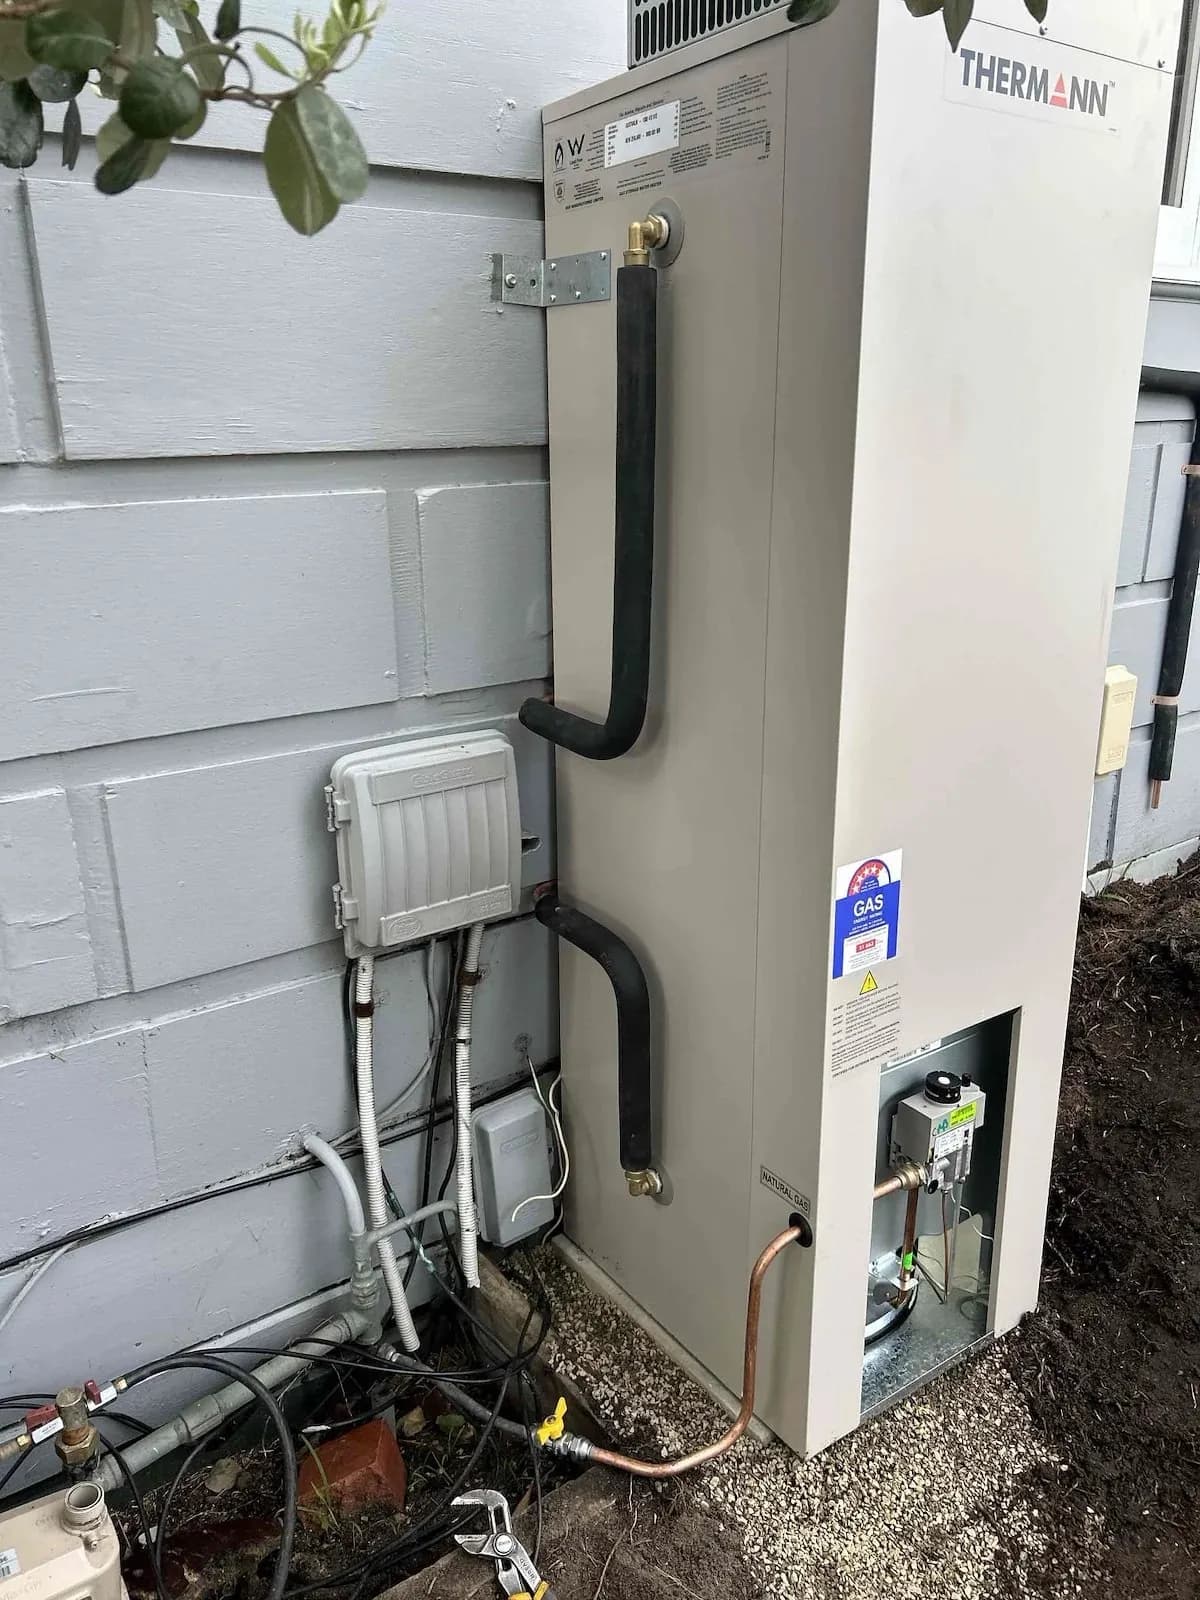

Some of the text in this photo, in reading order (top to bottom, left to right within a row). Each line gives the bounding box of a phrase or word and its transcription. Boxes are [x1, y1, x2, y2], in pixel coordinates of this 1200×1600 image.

[960, 48, 1108, 117] THERMANN
[853, 893, 884, 917] GAS
[762, 1171, 808, 1212] NATURAL GAS
